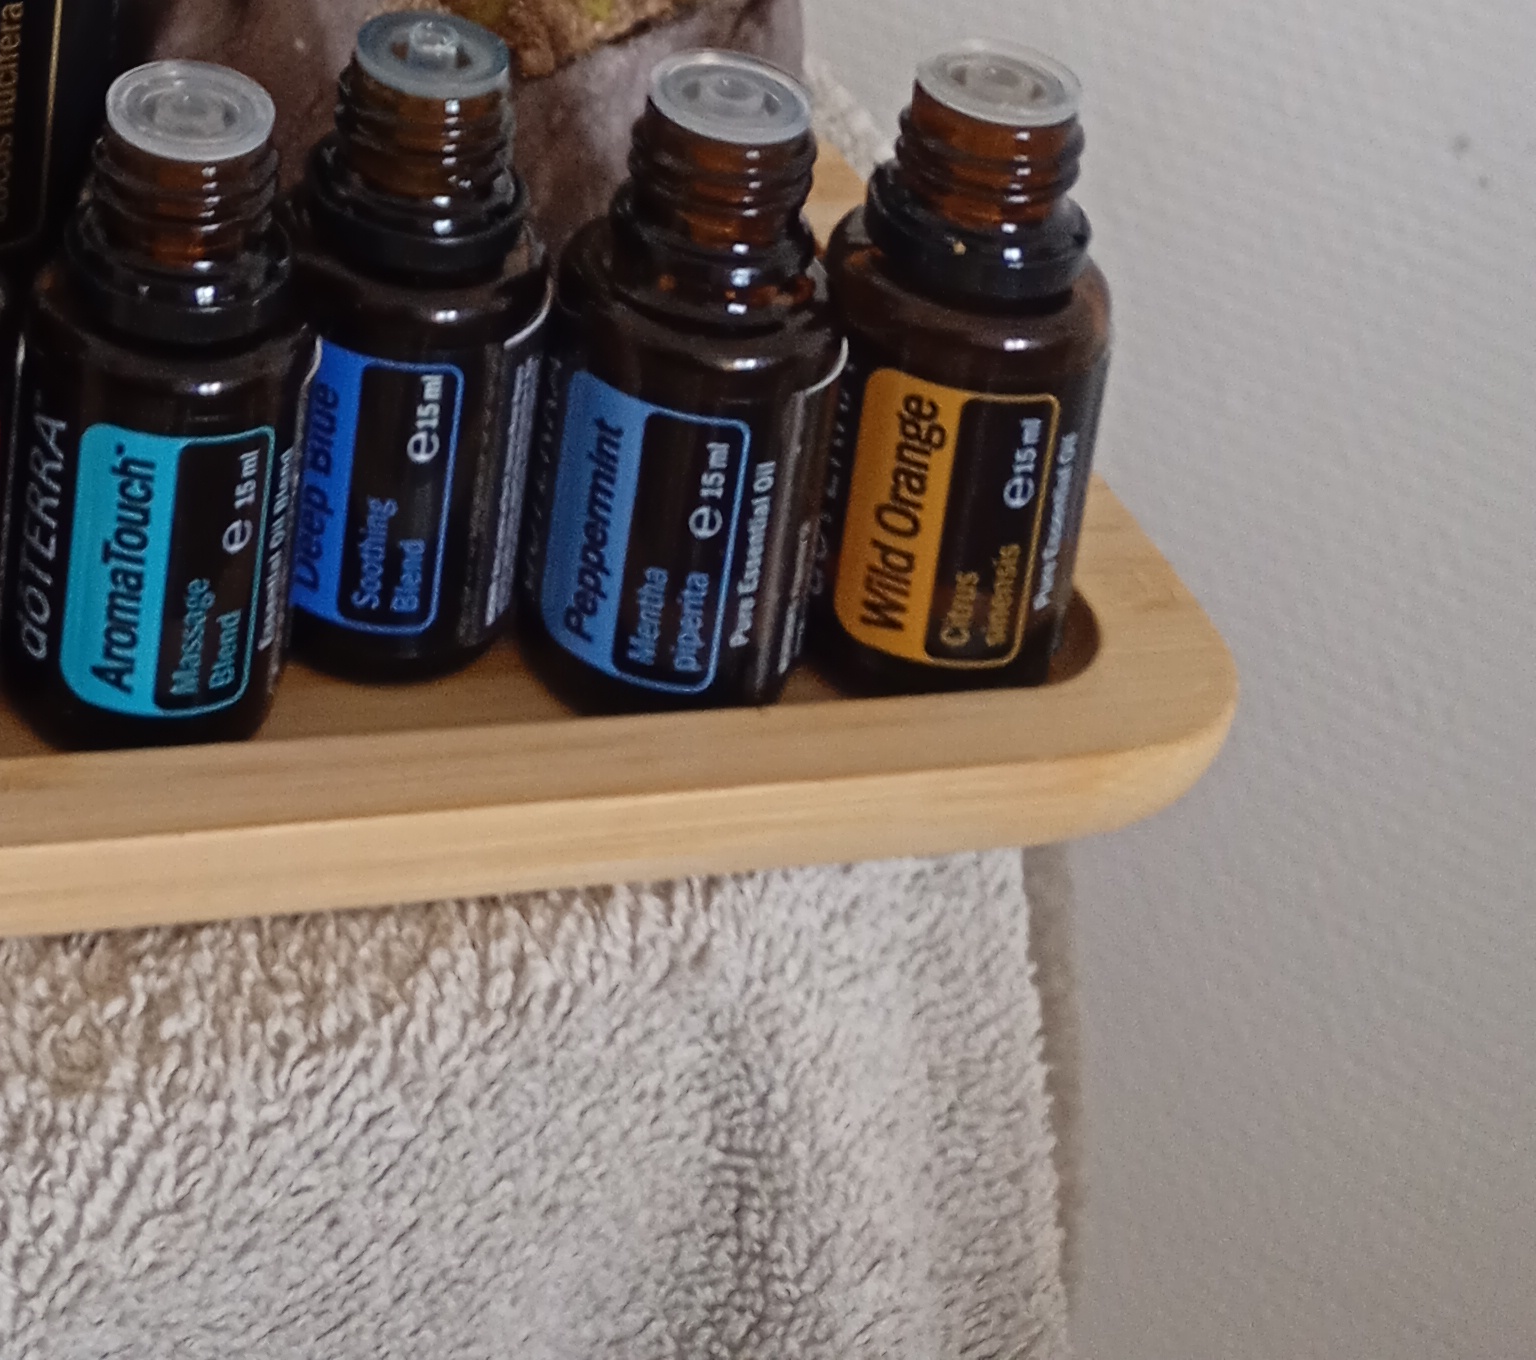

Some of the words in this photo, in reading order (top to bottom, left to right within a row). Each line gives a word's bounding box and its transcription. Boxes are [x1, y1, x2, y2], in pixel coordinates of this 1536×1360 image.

[416, 404, 442, 430] 15
[421, 375, 444, 402] ml
[239, 449, 260, 478] ml
[706, 442, 729, 470] ml
[874, 394, 947, 538] Orange
[1013, 449, 1037, 478] 15
[1020, 417, 1041, 445] ml
[235, 479, 257, 510] 15
[700, 472, 725, 500] 15
[754, 461, 777, 493] Oil
[351, 495, 398, 610] Soothing
[563, 417, 624, 642] Peppermint
[737, 496, 771, 596] Essential
[390, 538, 426, 613] Blend
[860, 538, 916, 632] Wild
[940, 571, 979, 647] Citrus
[169, 578, 216, 696] Massage
[209, 609, 242, 690] Blend
[628, 566, 668, 666] Mentha
[671, 572, 710, 673] piperita
[729, 596, 756, 648] Pure
